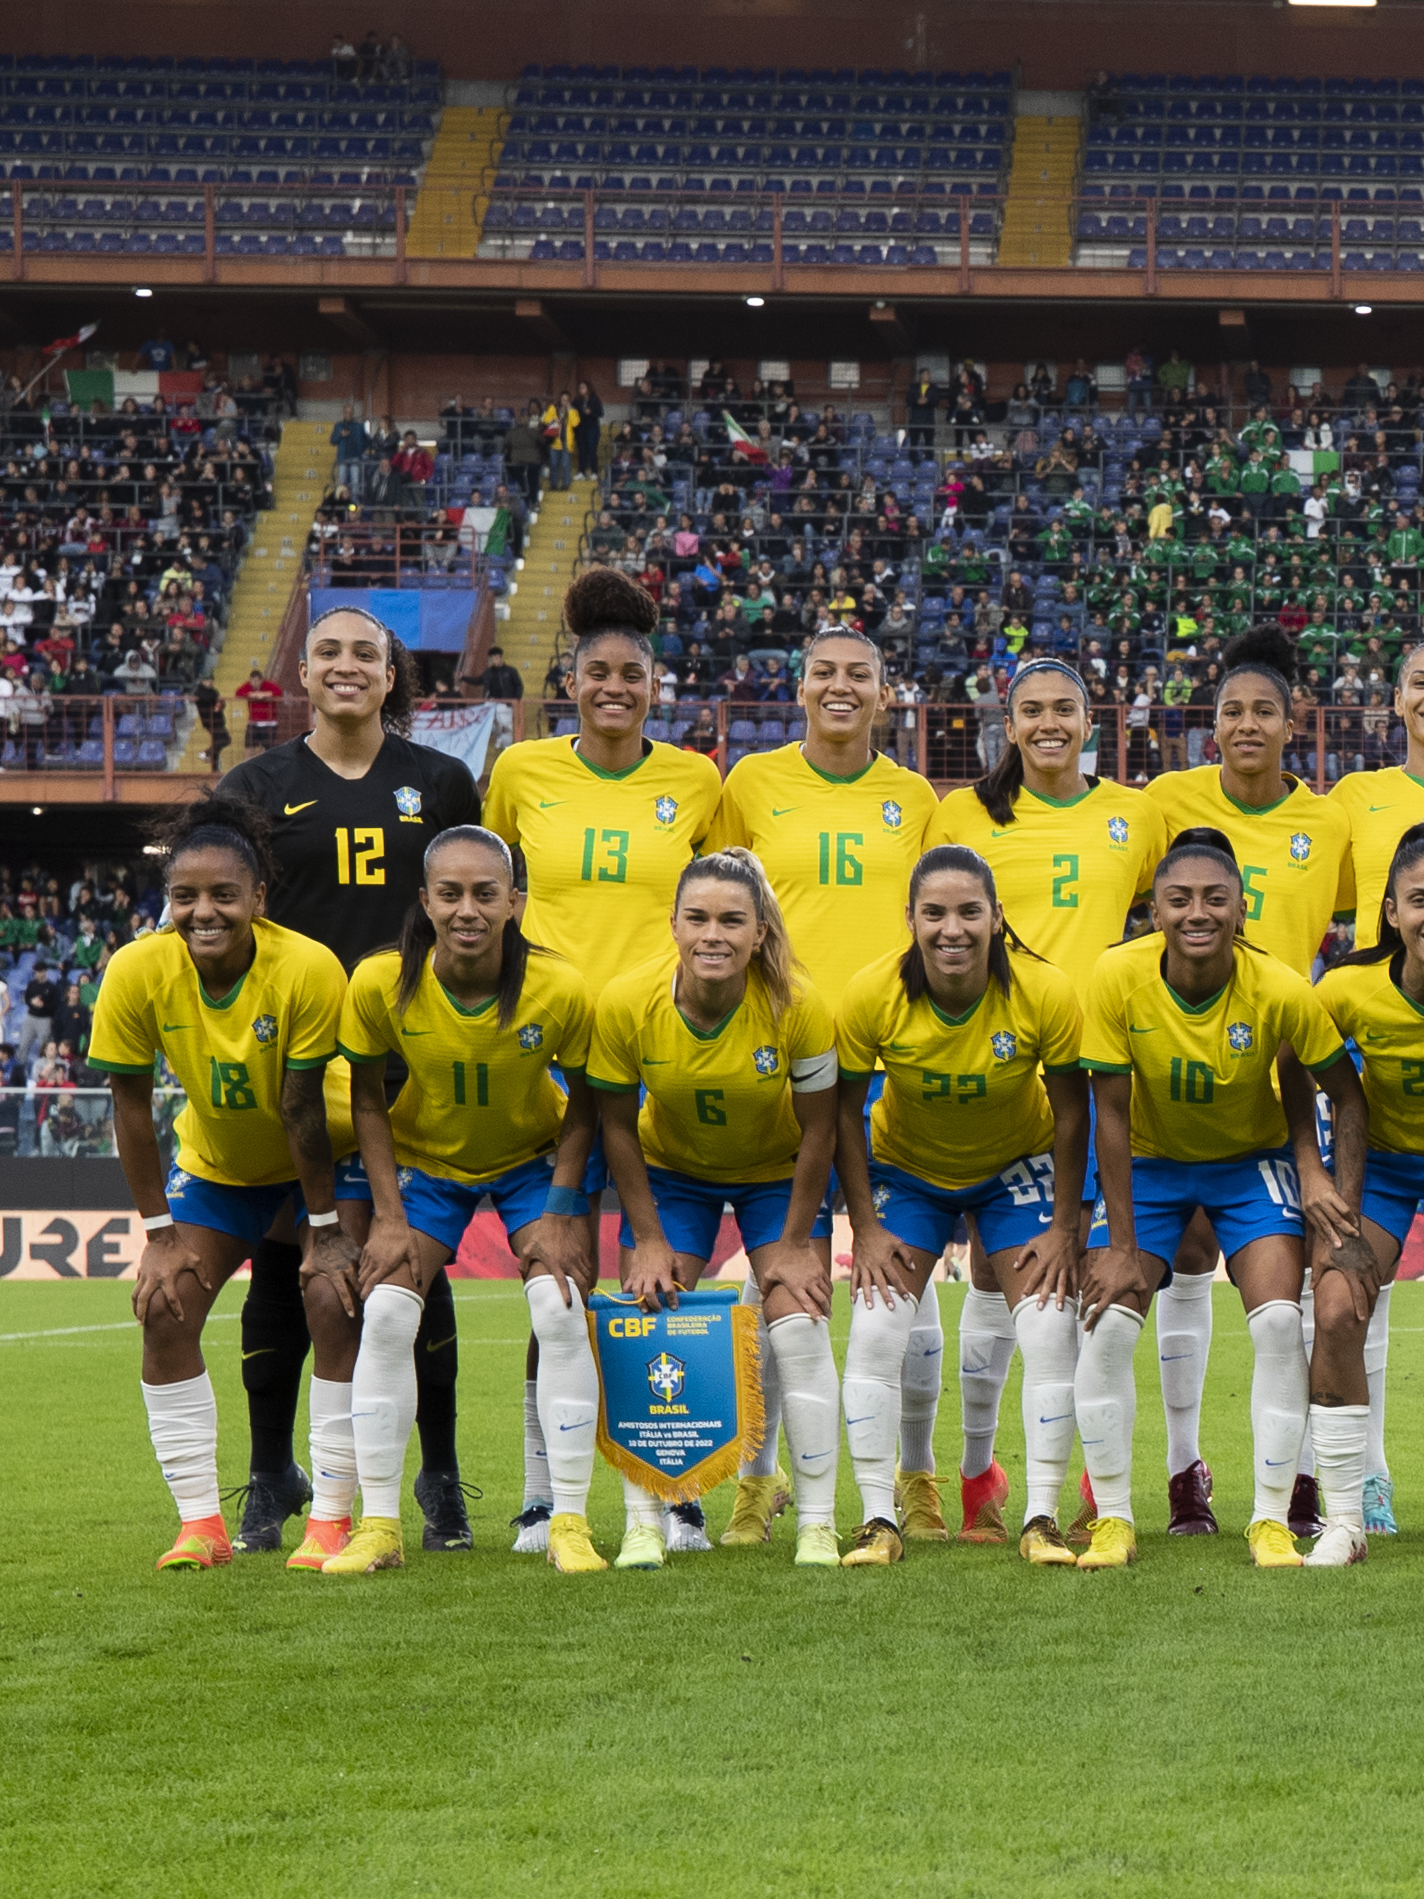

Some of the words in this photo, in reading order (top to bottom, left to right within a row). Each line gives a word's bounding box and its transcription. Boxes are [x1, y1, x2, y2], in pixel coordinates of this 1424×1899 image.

[335, 827, 385, 885] 12
[581, 827, 629, 883] 13
[819, 832, 864, 886] 16
[1052, 854, 1079, 908] 2
[209, 1055, 258, 1111] 18
[452, 1060, 489, 1106] 11
[1170, 1056, 1214, 1105] 10
[694, 1089, 728, 1127] 6
[1258, 1159, 1303, 1211] 10
[608, 1317, 657, 1338] CBF
[618, 1421, 658, 1429] AMISTOSOS
[658, 1420, 722, 1429] INTERNACIONAIS
[649, 1404, 689, 1414] BRASIL
[639, 1430, 663, 1438] ITÁLIA
[672, 1430, 699, 1438] BRASIL
[659, 1457, 684, 1465] ITÁLIA
